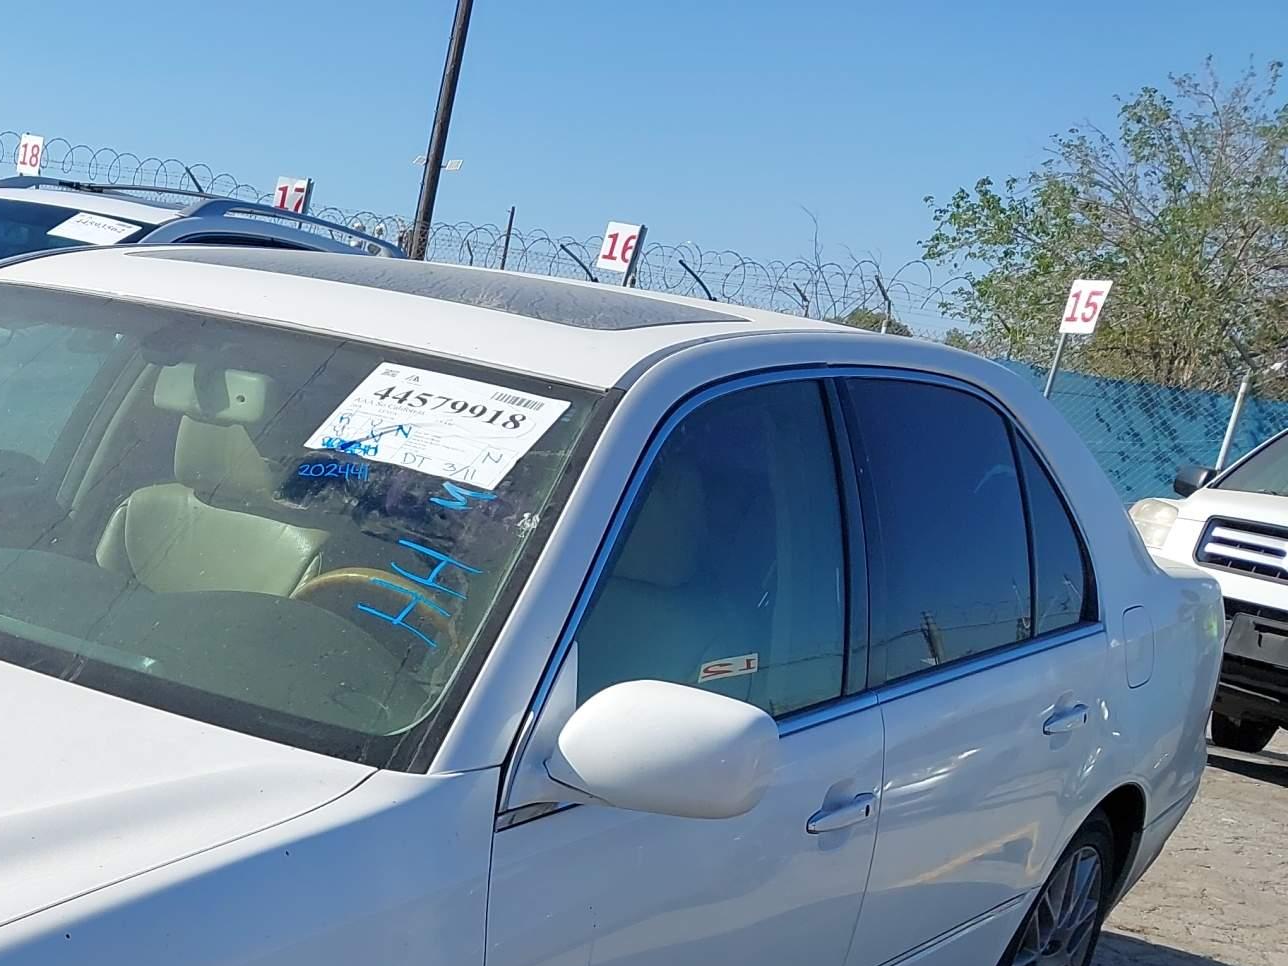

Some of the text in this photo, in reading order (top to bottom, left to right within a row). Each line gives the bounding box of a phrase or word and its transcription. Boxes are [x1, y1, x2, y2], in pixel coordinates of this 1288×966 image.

[19, 142, 41, 167] 18
[274, 185, 305, 213] 17
[601, 232, 637, 264] 16
[1064, 289, 1105, 323] 15
[373, 385, 528, 430] 44579918
